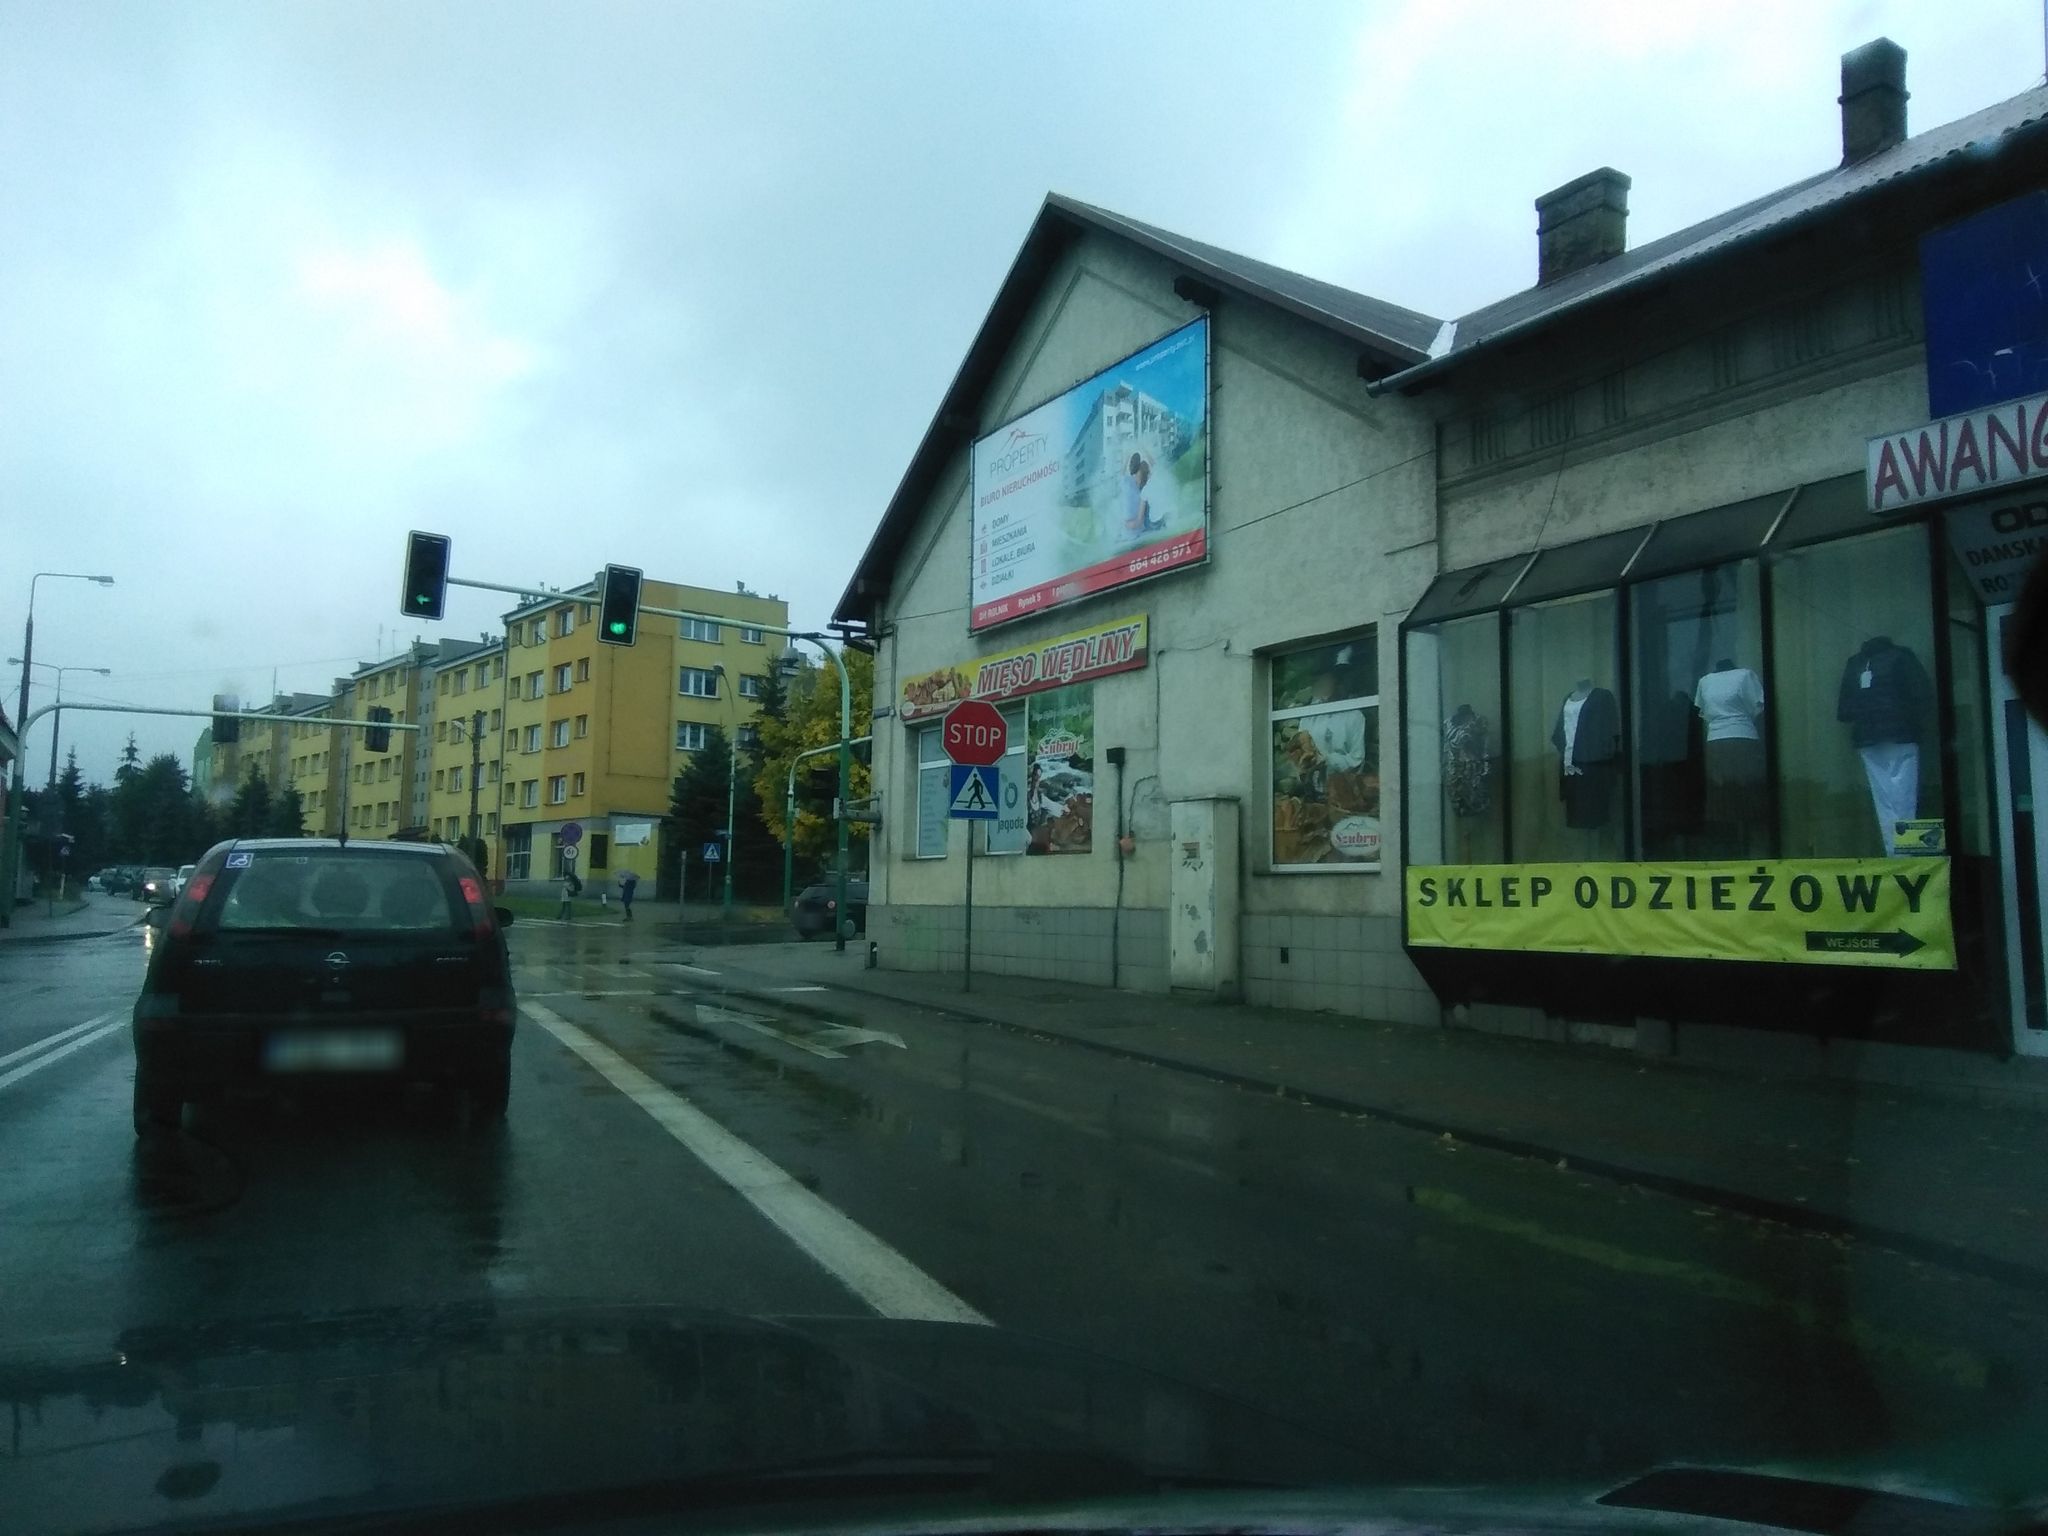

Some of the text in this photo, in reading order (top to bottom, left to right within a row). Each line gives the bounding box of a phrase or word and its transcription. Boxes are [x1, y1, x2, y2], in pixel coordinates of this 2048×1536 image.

[990, 433, 1048, 478] PROPERTY
[980, 461, 1060, 508] BIURO NIERUCHOMOŚCI
[992, 513, 1009, 529] DOMY
[991, 525, 1027, 547] MIESZKANIA
[1019, 594, 1036, 609] Rynek
[976, 623, 1141, 698] MIĘSO WĘDLINY
[950, 723, 1001, 748] STOP
[1418, 867, 1932, 913] SKLEP ODZIEŻOWY
[1825, 936, 1880, 949] WEJŚCIE
